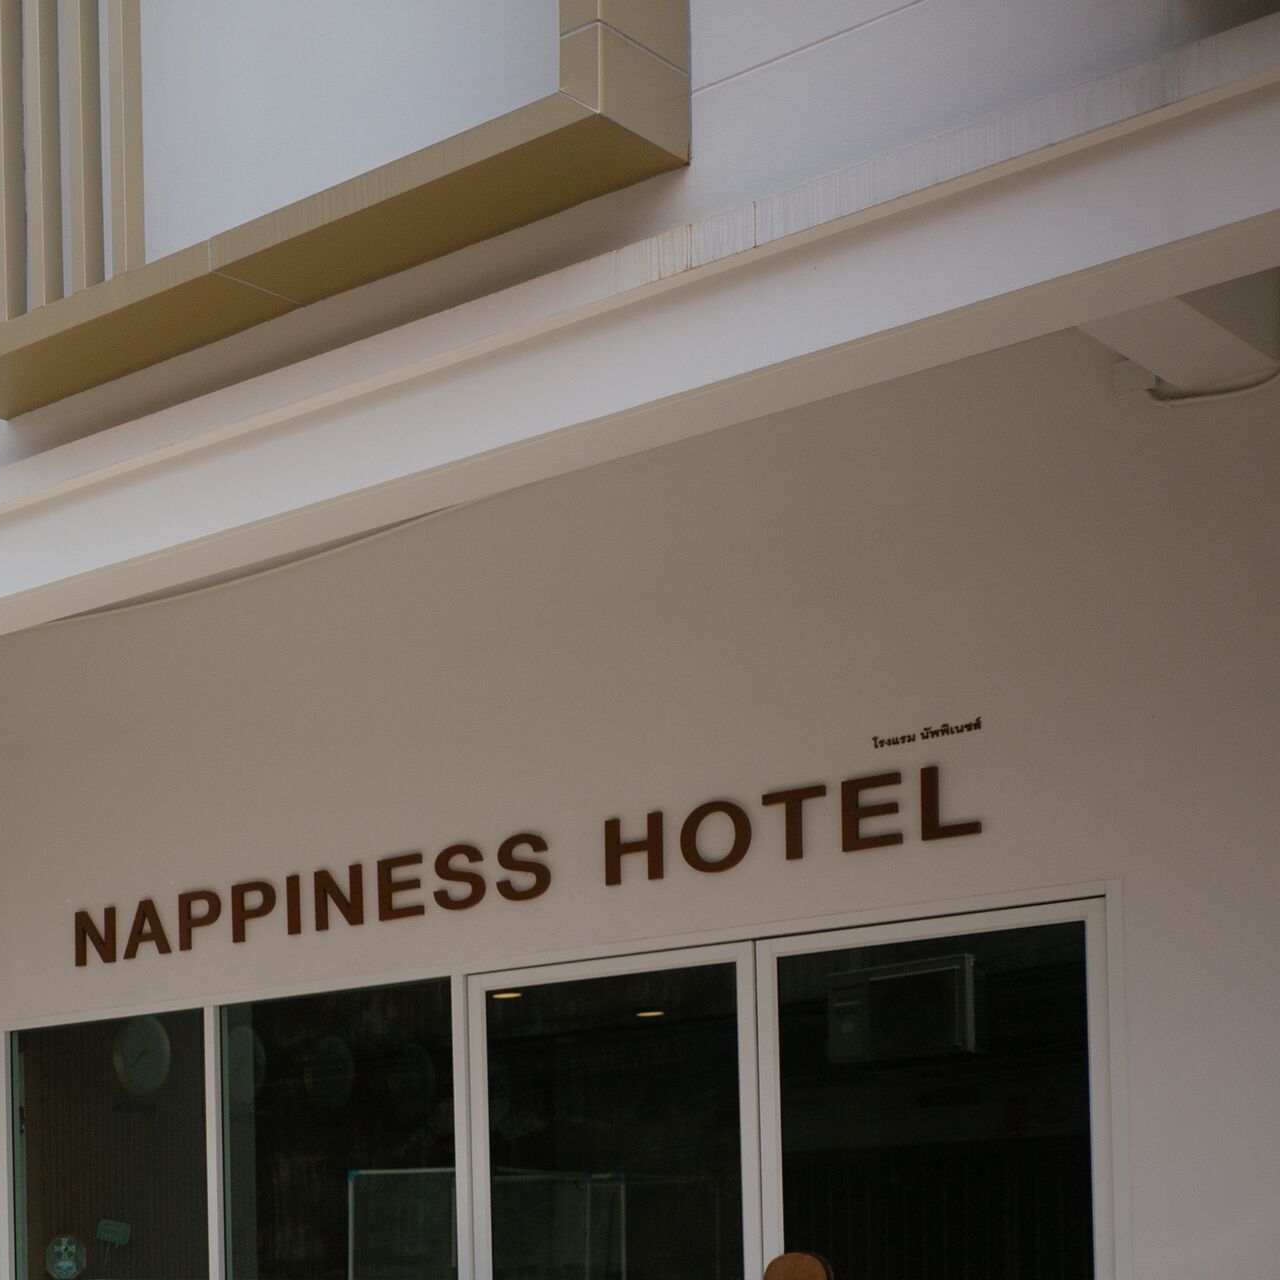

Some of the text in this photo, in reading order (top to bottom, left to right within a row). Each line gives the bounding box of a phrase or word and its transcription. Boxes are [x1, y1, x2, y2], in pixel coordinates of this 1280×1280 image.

[871, 734, 917, 749] โรงแรม
[73, 765, 984, 969] NAPPINESS HOTEL
